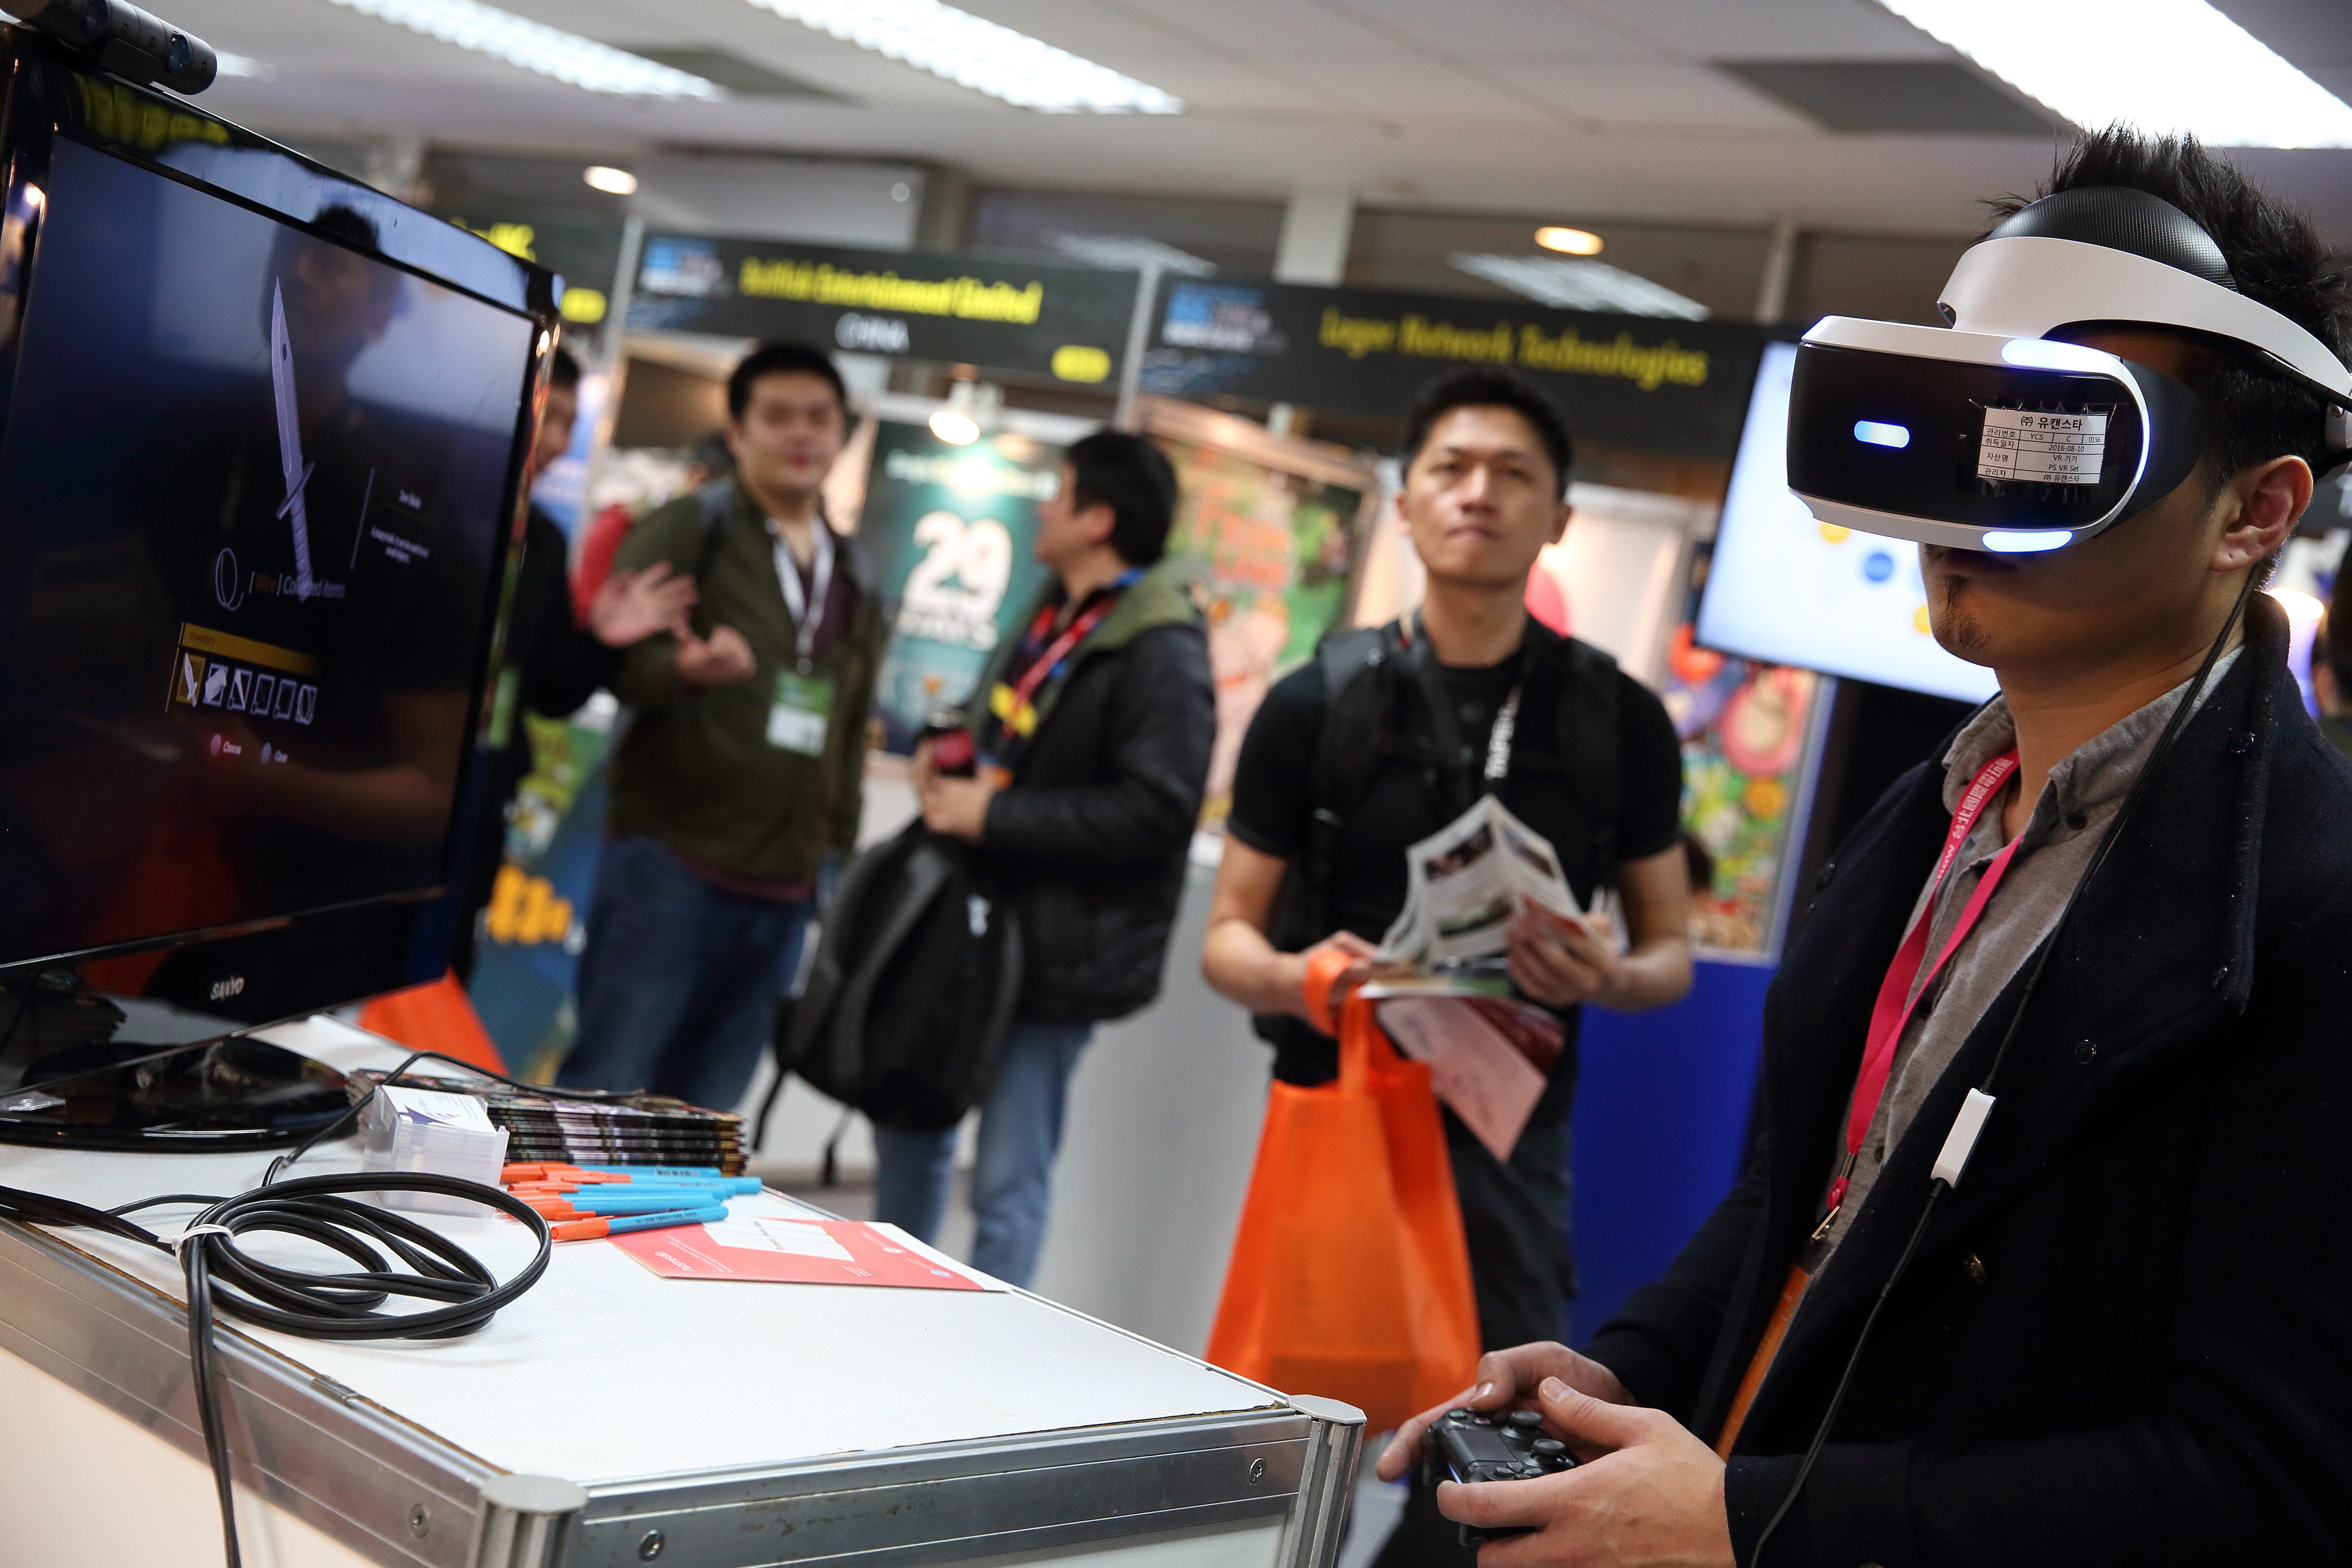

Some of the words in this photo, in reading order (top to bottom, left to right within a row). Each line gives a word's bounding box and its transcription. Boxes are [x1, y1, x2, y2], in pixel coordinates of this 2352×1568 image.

[1398, 314, 1512, 365] Network
[1518, 324, 1708, 391] Technologies
[2038, 417, 2082, 431] 유캔스타
[1987, 428, 2016, 438] 관리번호
[1985, 438, 2015, 448] 취득일자
[1987, 453, 2008, 462] 자산명
[1984, 468, 2006, 478] 관리자
[1952, 757, 2014, 839] 台北國際電玩展
[210, 976, 244, 1002] SANYO
